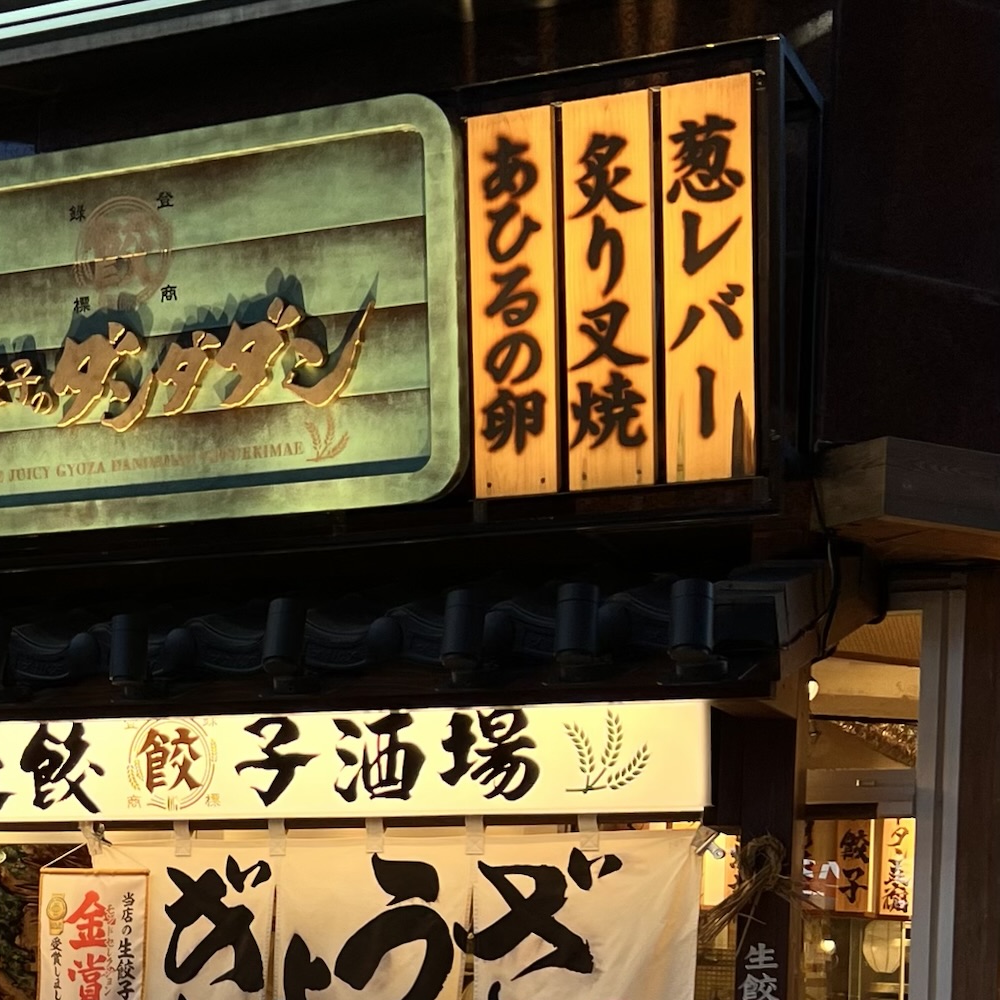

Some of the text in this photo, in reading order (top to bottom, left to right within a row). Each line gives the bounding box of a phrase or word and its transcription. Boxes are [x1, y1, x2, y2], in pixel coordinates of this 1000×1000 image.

[480, 136, 546, 455] あひるの卵
[569, 133, 649, 449] 炙り叉焼
[666, 114, 745, 438] 葱レバー
[8, 466, 50, 483] JUICY
[56, 459, 105, 478] GYOZA
[838, 828, 870, 904] 餃子
